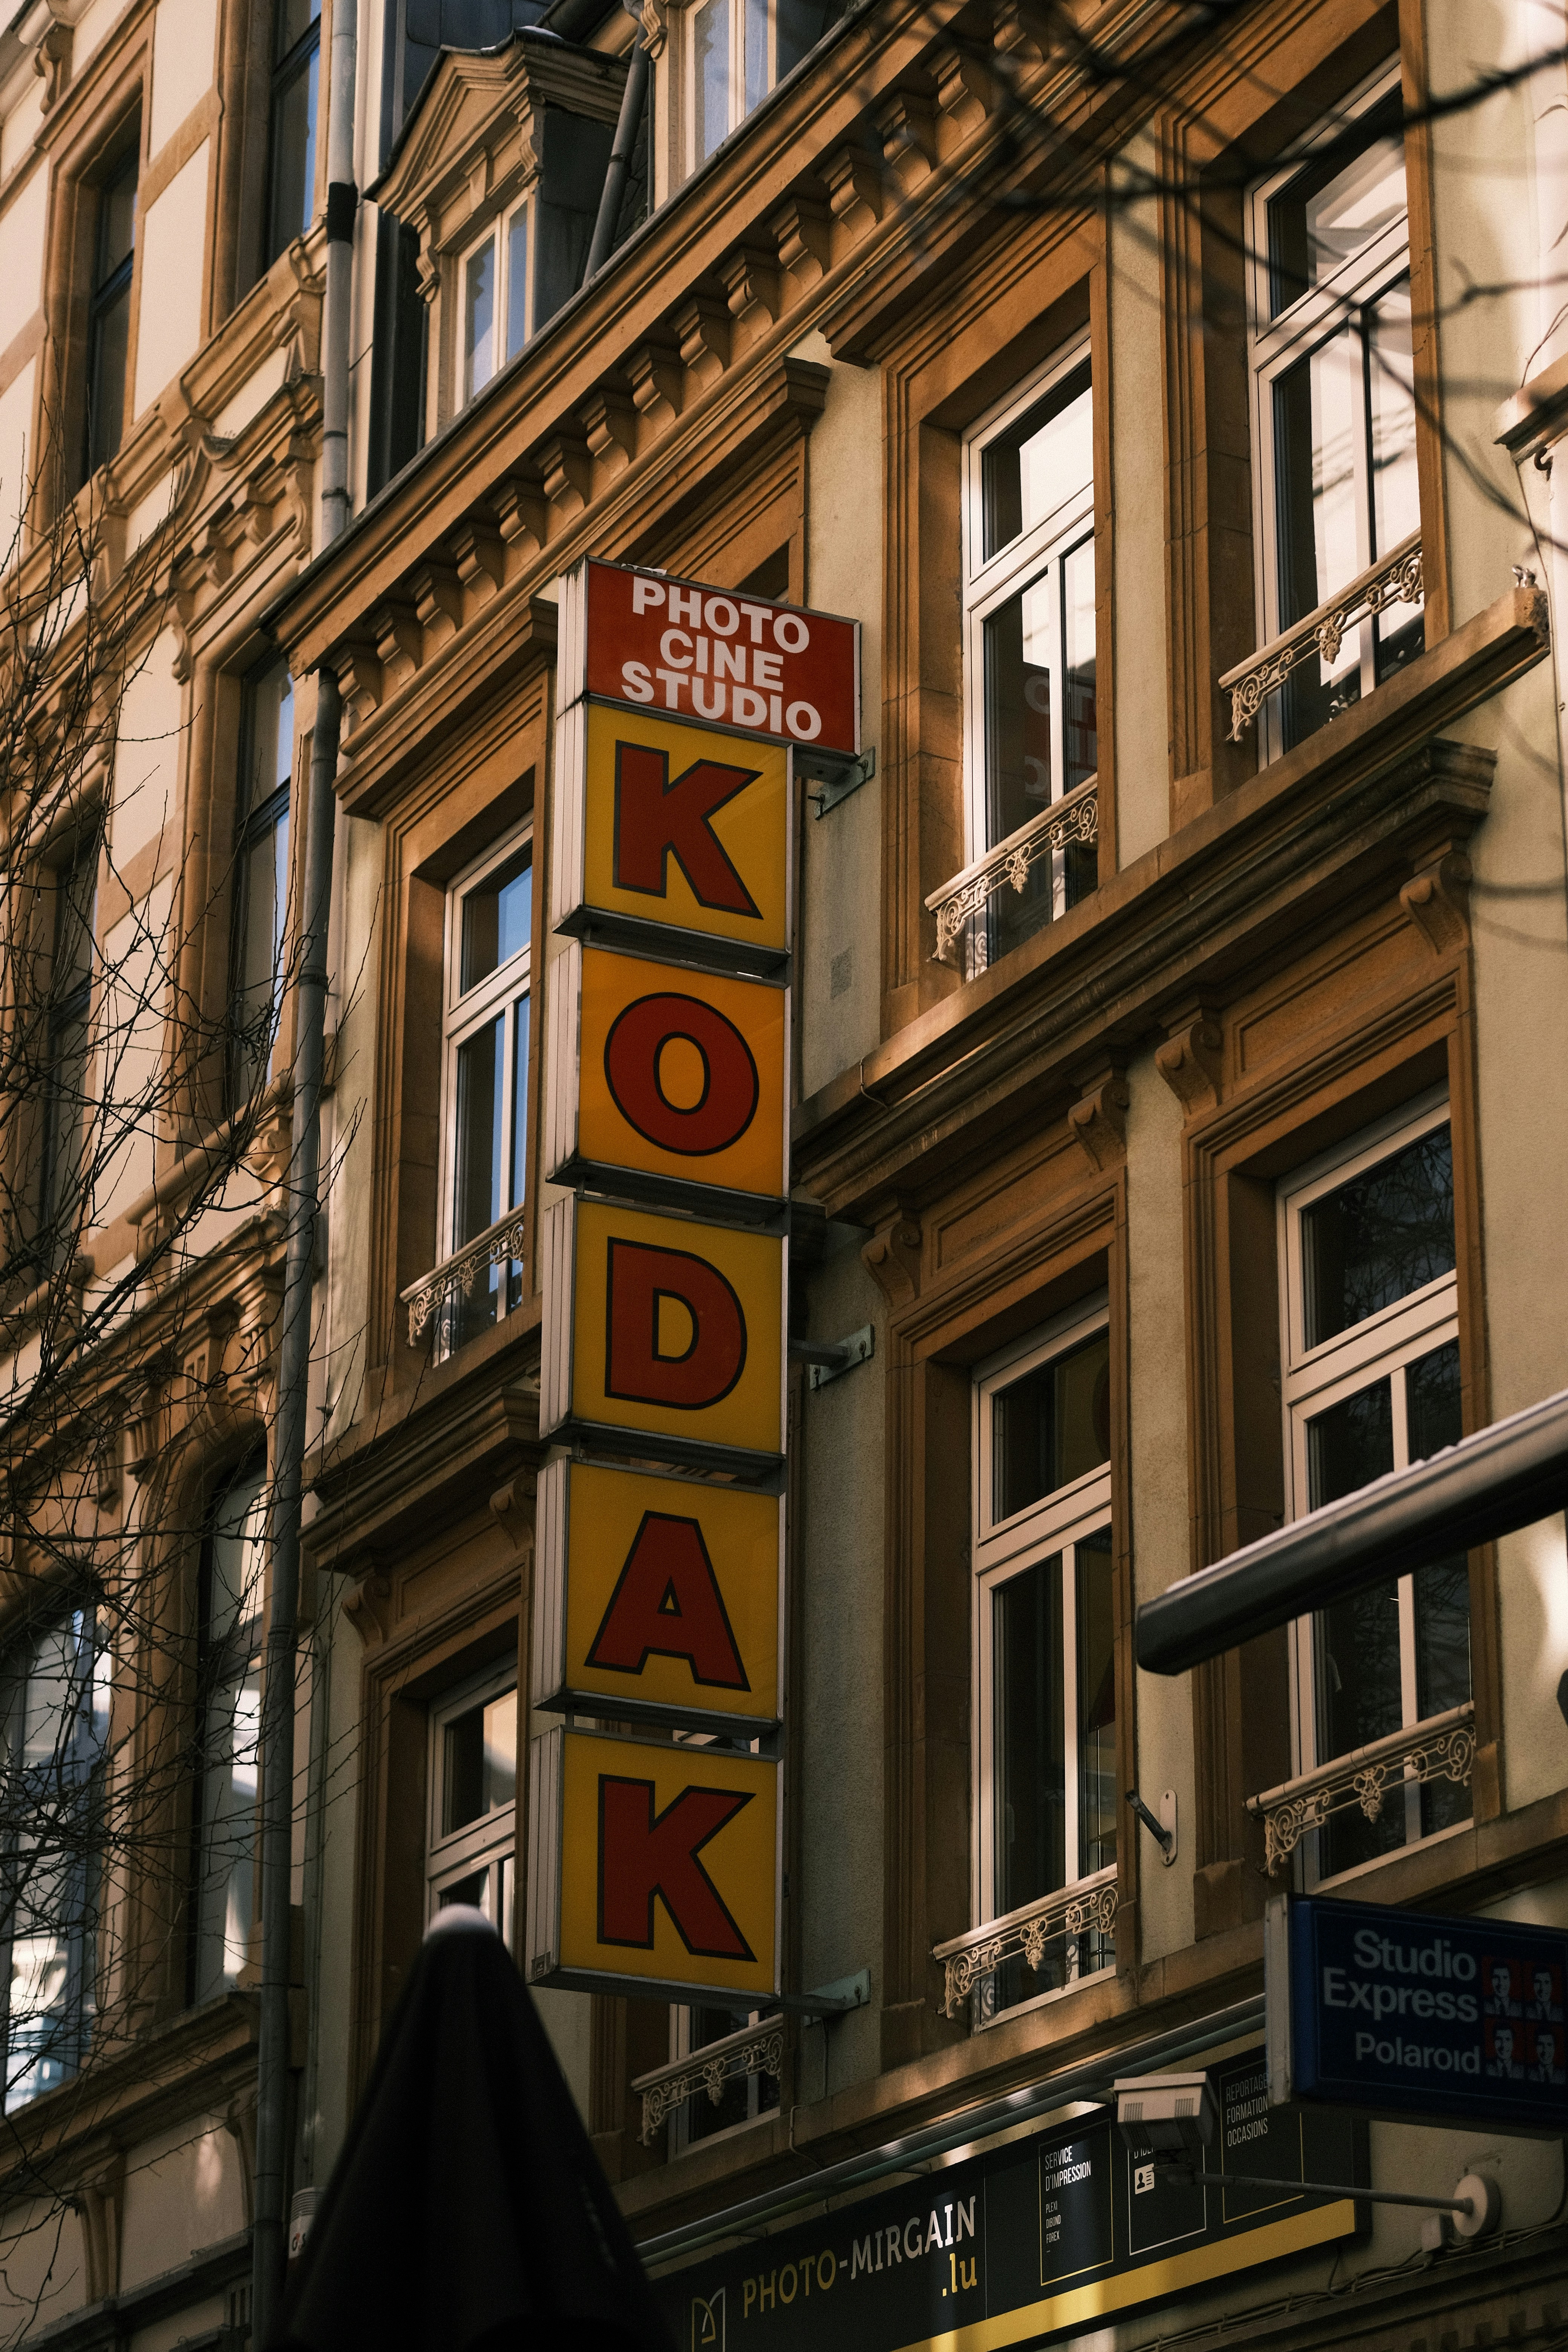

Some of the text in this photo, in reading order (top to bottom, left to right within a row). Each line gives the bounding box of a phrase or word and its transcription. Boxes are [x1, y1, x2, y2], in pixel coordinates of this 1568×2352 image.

[633, 576, 810, 654] PHOTO
[660, 629, 784, 692] CINE
[622, 661, 822, 740] STUDIO
[1354, 1929, 1477, 1981] Studio
[1323, 1966, 1478, 2022] Express
[1356, 2032, 1481, 2074] Polaroid
[1227, 2095, 1268, 2125] FORMATION
[1227, 2118, 1268, 2147] OCCASIONS
[1045, 2145, 1072, 2170] SERVICE
[1045, 2160, 1091, 2191] D'IMPRESSION
[1046, 2200, 1058, 2213] PLEXI
[1046, 2215, 1061, 2228] DIBOND
[743, 2195, 976, 2318] PHOTO-MIRGAIN
[1046, 2230, 1060, 2243] FOREX
[942, 2253, 977, 2297] .lu
